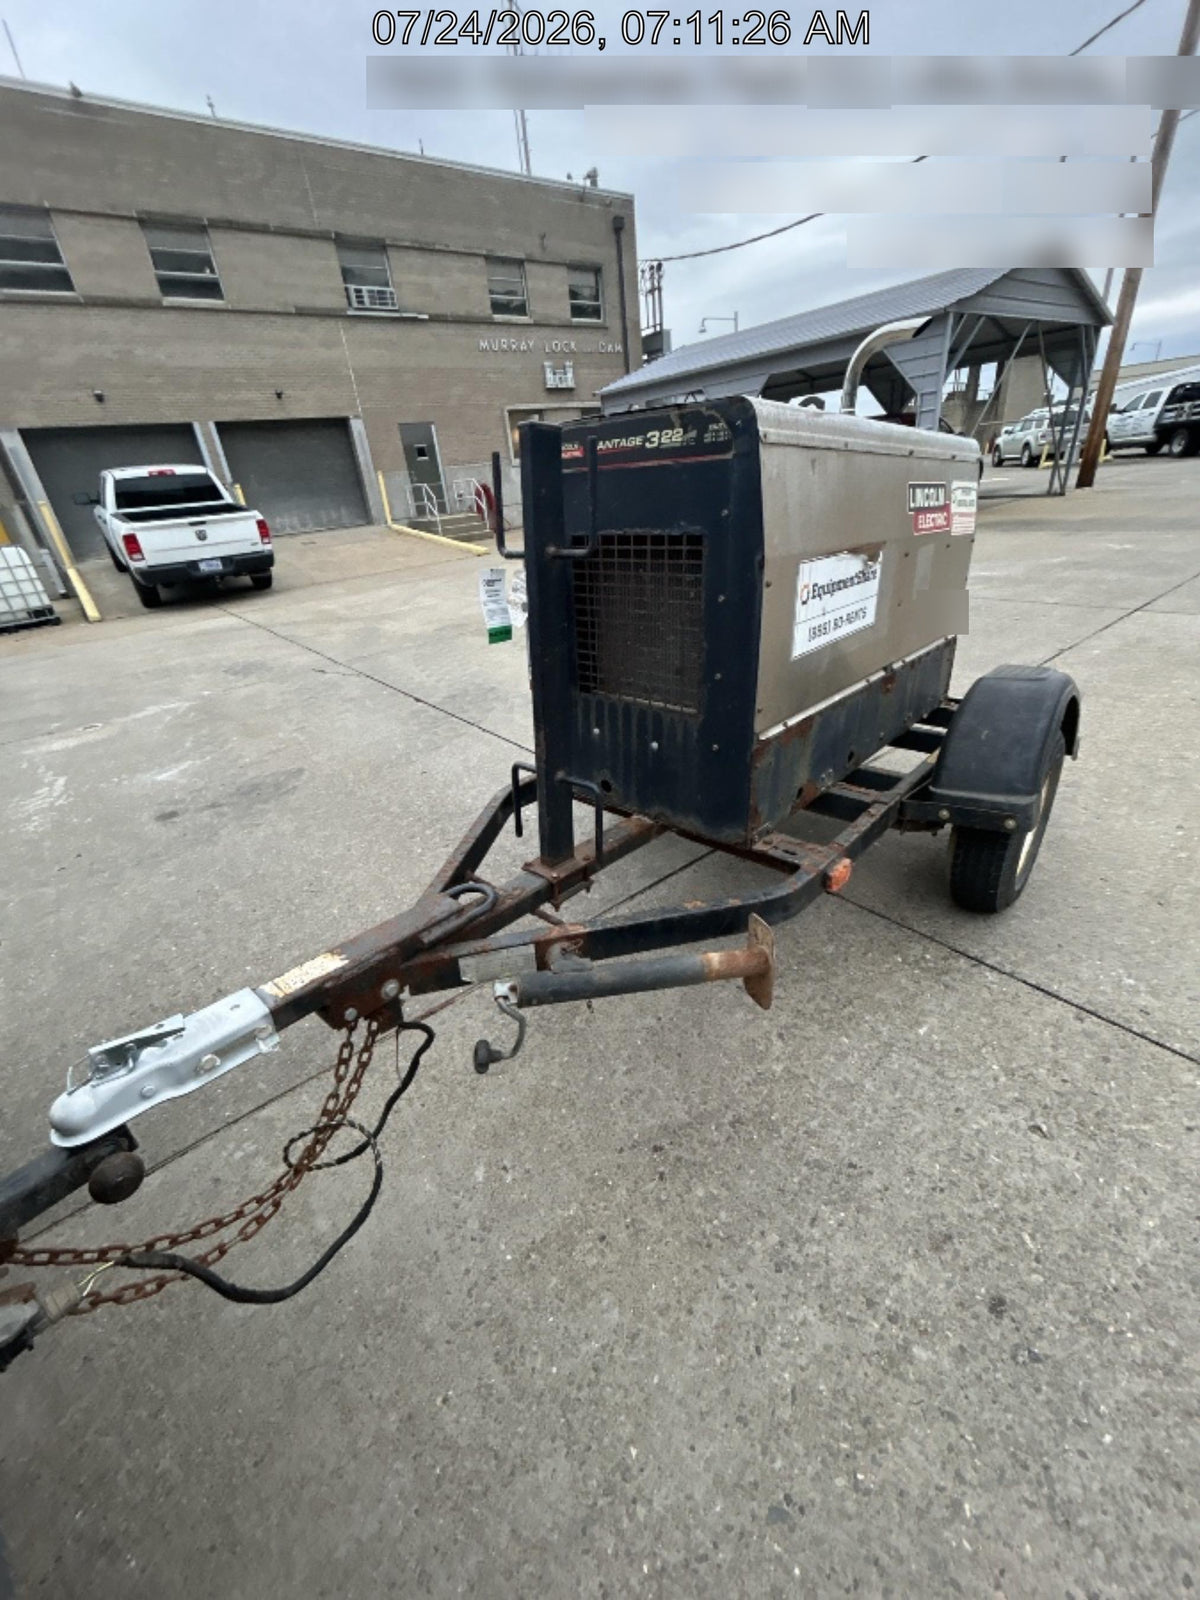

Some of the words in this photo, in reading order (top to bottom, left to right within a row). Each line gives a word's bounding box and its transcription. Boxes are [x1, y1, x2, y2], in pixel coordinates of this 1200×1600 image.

[478, 338, 535, 351] MURRAY
[544, 340, 577, 353] LOCK
[909, 486, 946, 509] LINCOLN
[918, 511, 948, 529] ELECTRIC
